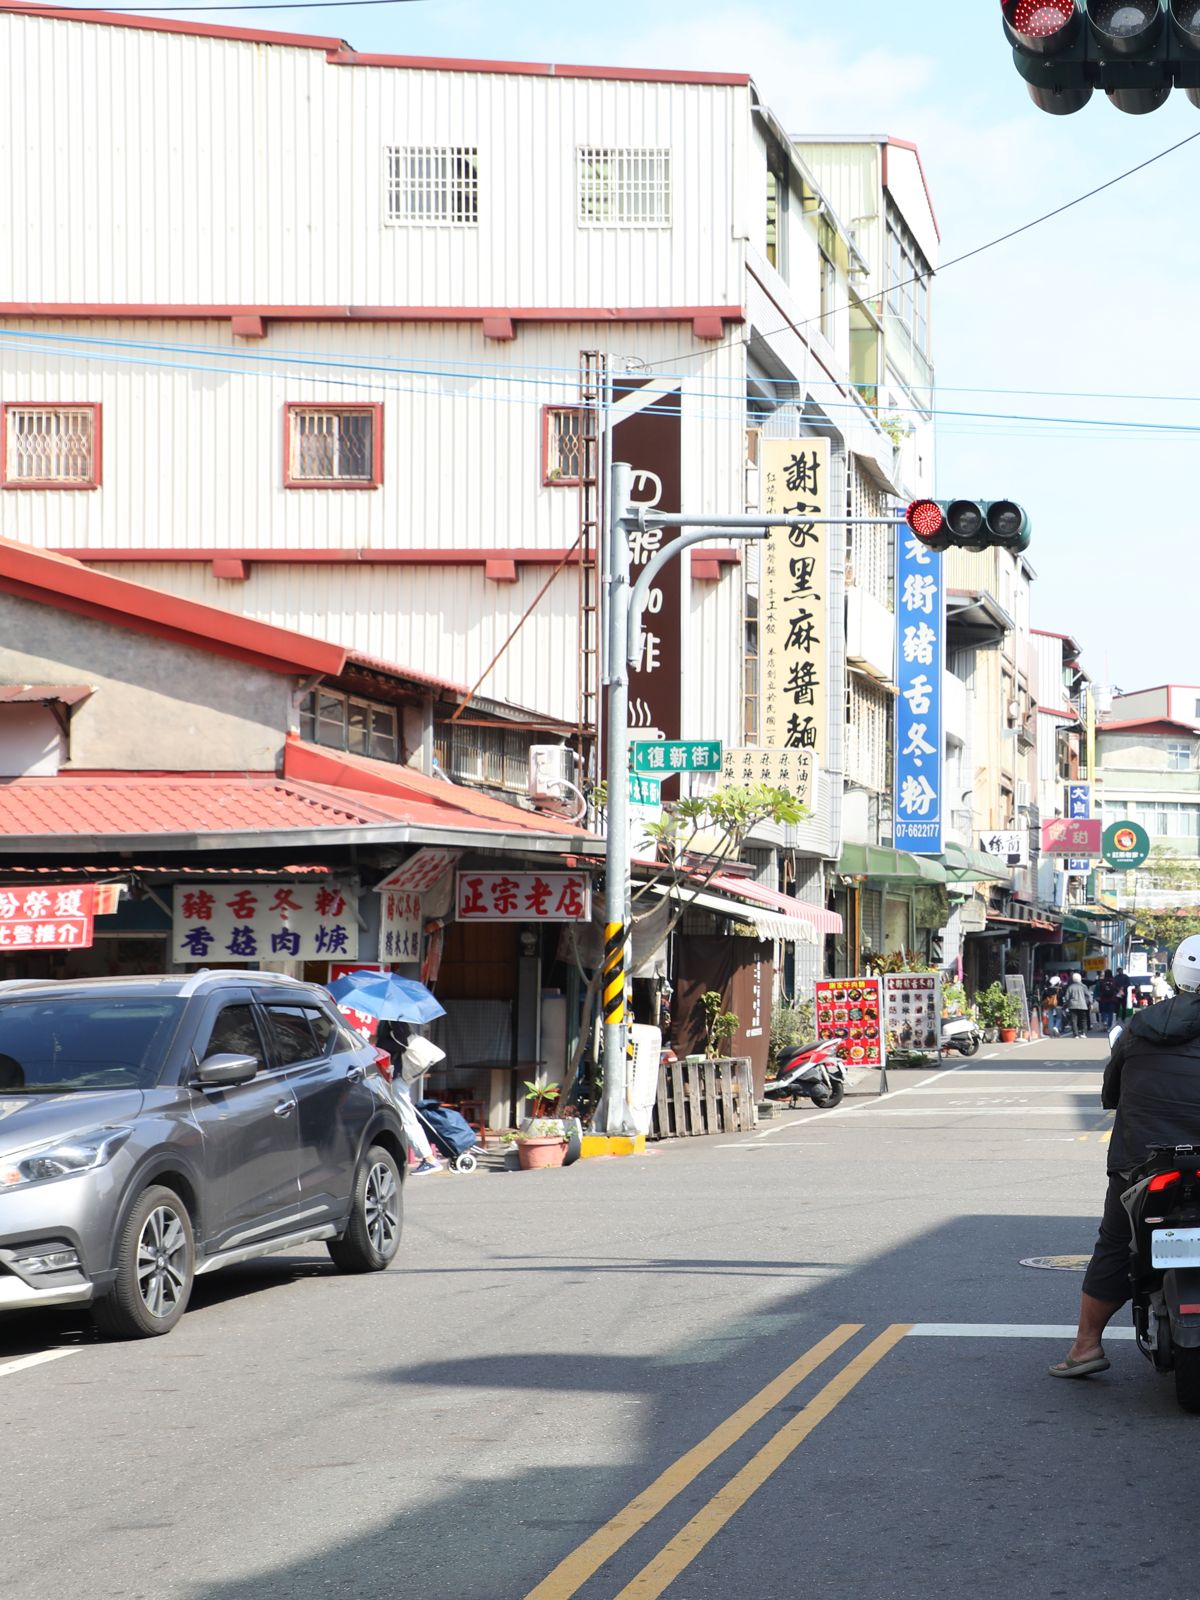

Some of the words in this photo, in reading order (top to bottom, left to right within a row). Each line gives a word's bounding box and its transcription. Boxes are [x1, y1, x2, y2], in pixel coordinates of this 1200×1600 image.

[648, 746, 709, 768] 復新街
[896, 823, 940, 838] 07-6622177
[181, 887, 347, 921] 豬舌冬粉
[461, 877, 584, 917] 正宗老店
